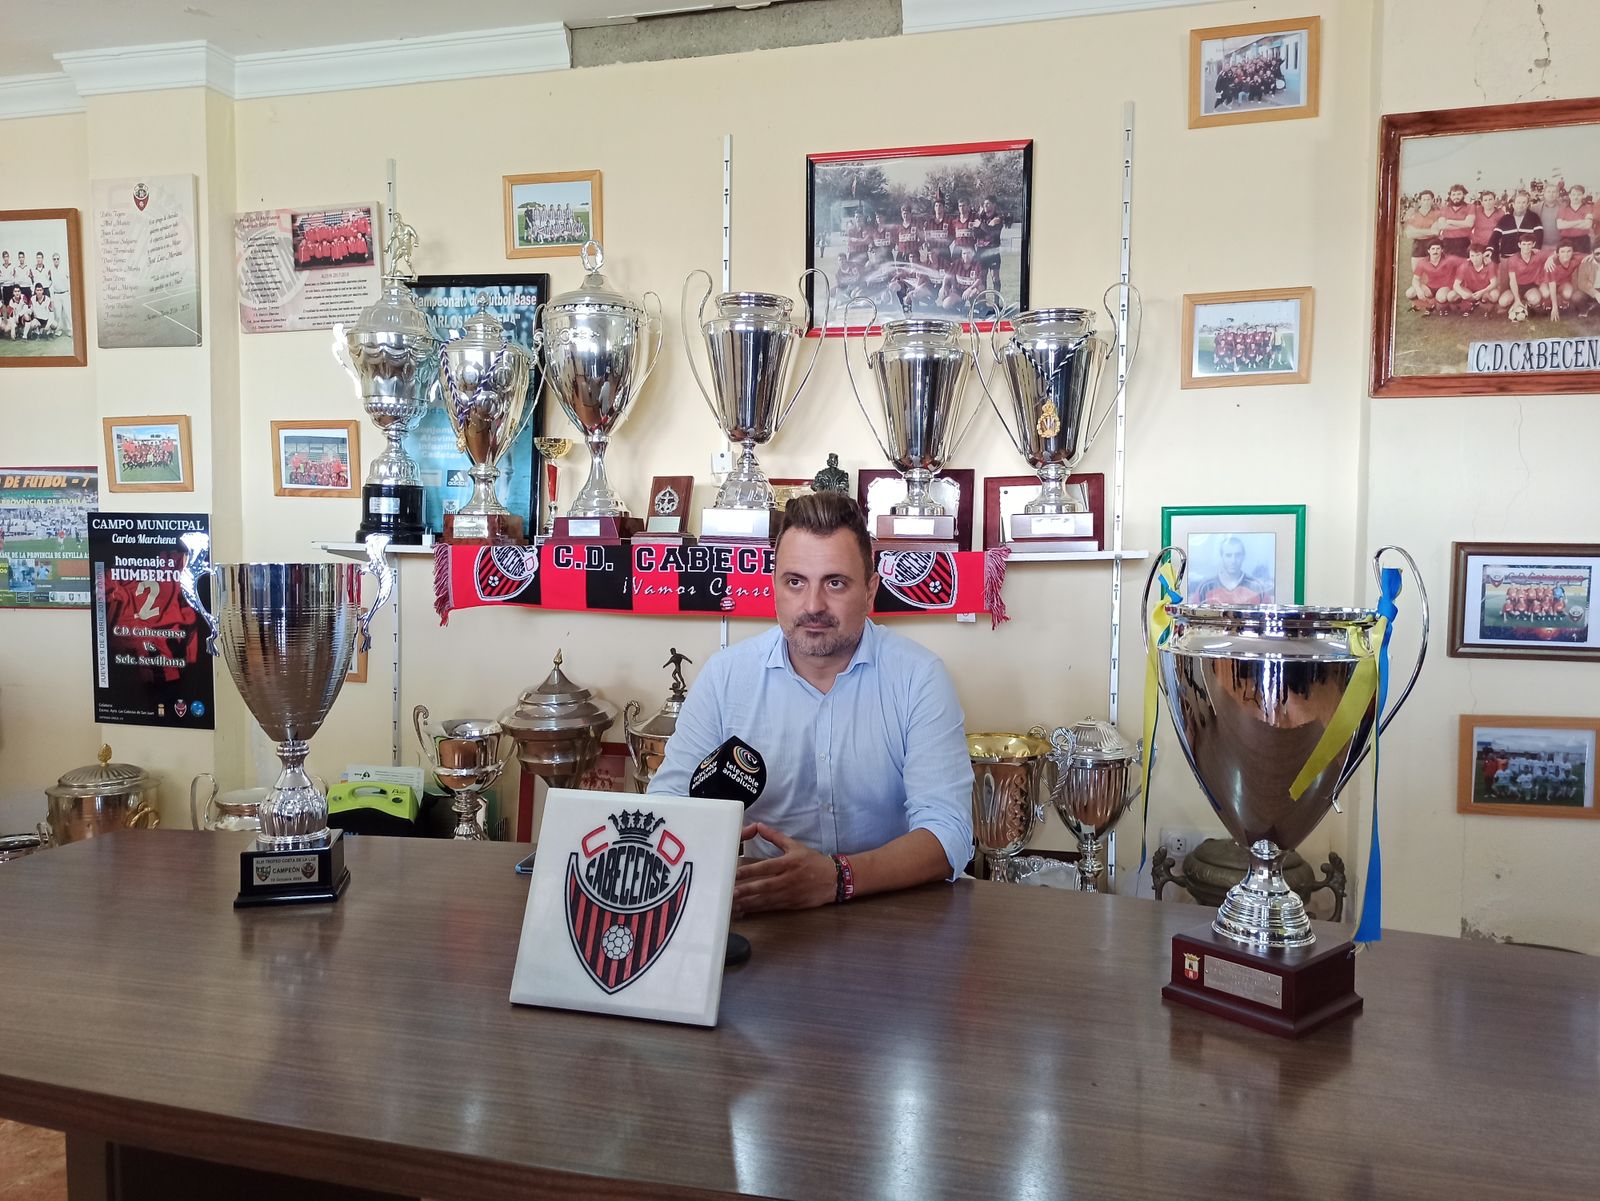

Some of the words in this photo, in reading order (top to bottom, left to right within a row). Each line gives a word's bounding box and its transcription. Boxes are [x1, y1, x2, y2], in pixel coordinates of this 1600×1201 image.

[514, 292, 537, 306] Base
[1476, 339, 1600, 372] C.D.CABECEN
[4, 475, 22, 488] DE
[92, 518, 134, 530] CAMPO
[136, 519, 205, 531] MUNICIPAL
[112, 533, 136, 544] Carlos
[137, 533, 177, 545] Marchena
[115, 555, 166, 568] homenaje
[168, 559, 174, 567] a
[552, 545, 614, 572] C.D.
[111, 568, 180, 582] HUMBERTO
[709, 576, 771, 598] Cense
[134, 580, 160, 620] 2
[133, 627, 187, 639] Cabecense
[139, 655, 185, 667] Sevillana
[725, 761, 759, 788] telecable
[581, 825, 609, 858] C
[656, 829, 685, 865] D
[272, 866, 301, 874] CAMPEÓN
[585, 845, 671, 906] CABECENSE
